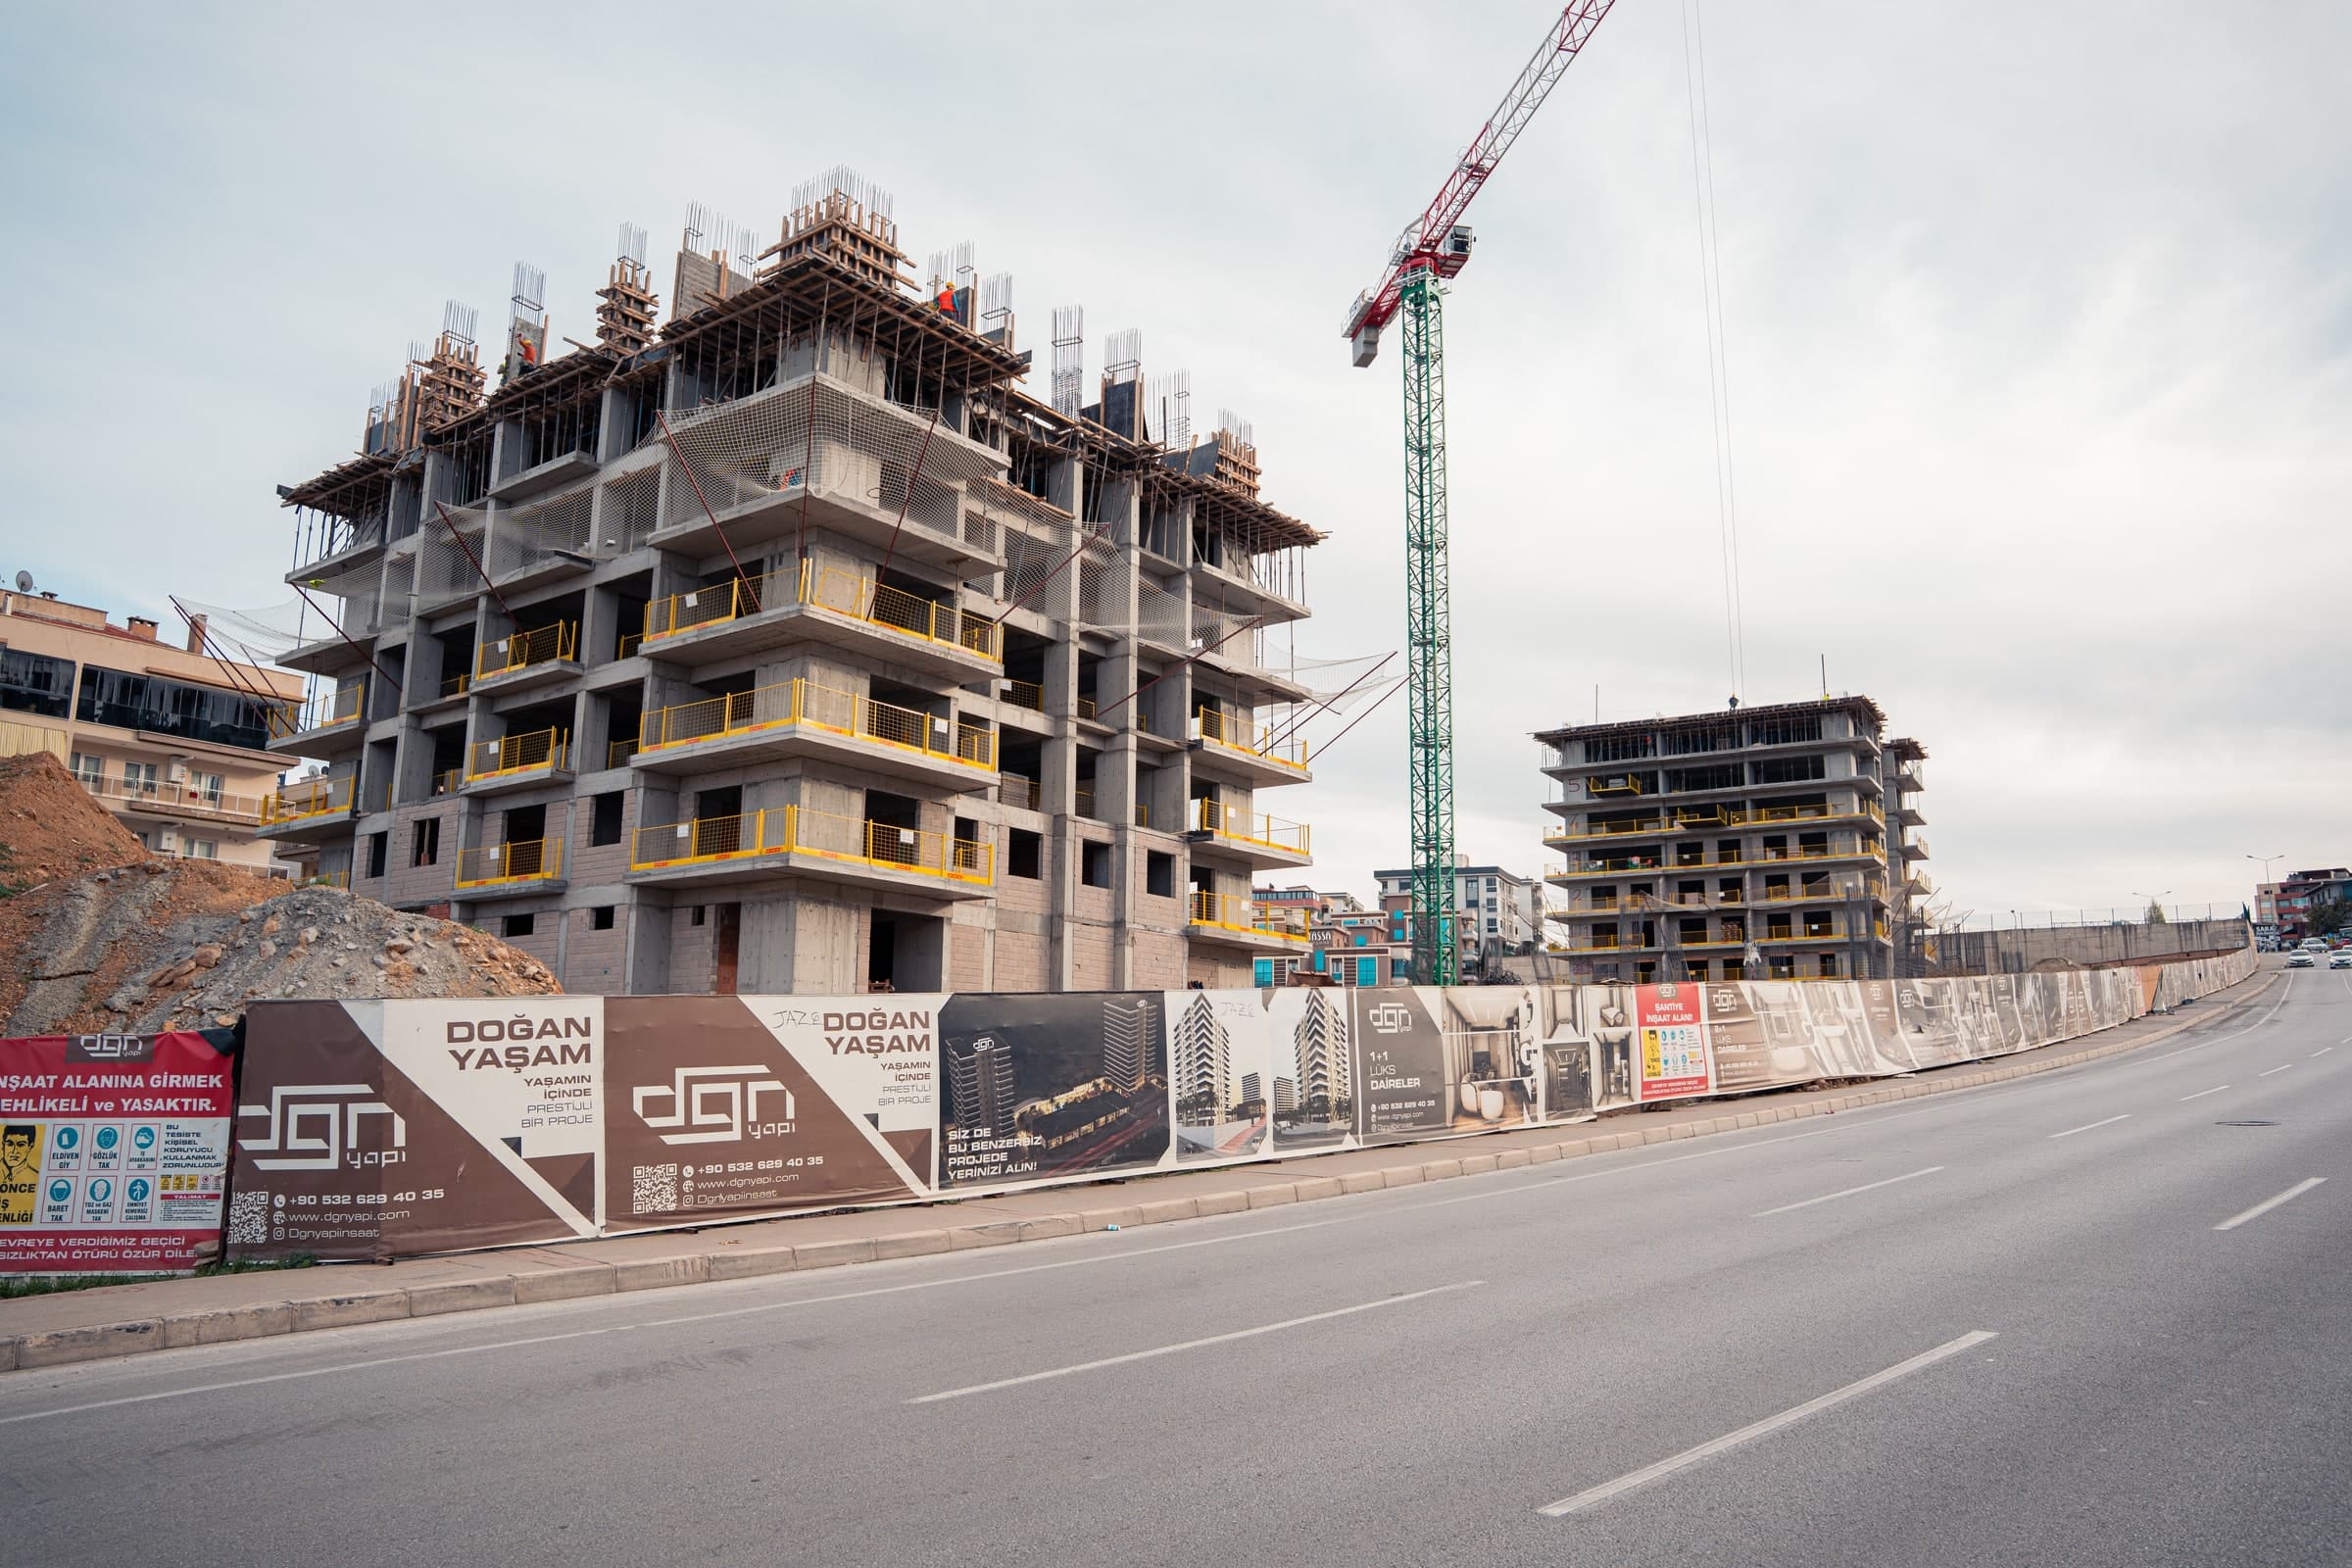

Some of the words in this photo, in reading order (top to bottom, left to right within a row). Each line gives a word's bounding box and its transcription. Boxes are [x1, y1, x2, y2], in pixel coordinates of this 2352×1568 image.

[823, 1007, 930, 1032] DOĞAN
[1369, 1003, 1412, 1034] dgn
[447, 1013, 591, 1044] DOĞAN
[80, 1035, 143, 1057] dgn
[824, 1034, 930, 1058] YAŞAM
[973, 1037, 995, 1052] dgn
[448, 1043, 592, 1074] YAŞAM
[1370, 1051, 1389, 1061] 1+1
[880, 1061, 931, 1071] YAŞAMIN
[1370, 1063, 1396, 1076] LÜKS
[63, 1075, 144, 1089] ALANINA
[149, 1072, 223, 1088] GİRMEK
[524, 1074, 592, 1088] YAŞAMIN
[895, 1072, 931, 1083] İÇİNDE
[1370, 1077, 1421, 1090] DAİRELER
[544, 1088, 593, 1102] İÇİNDE
[878, 1097, 895, 1106] BİR
[898, 1095, 931, 1104] PROJE
[0, 1096, 88, 1112] EHLİKELİ
[93, 1101, 115, 1112] ve
[121, 1098, 217, 1112] YASAKTIR.
[527, 1101, 593, 1114] PRESTİJLİ
[633, 1064, 795, 1146] dgn
[237, 1084, 406, 1171] dgn
[521, 1116, 544, 1129] BİR
[548, 1114, 593, 1127] PROJE
[949, 1127, 970, 1140] SİZ
[974, 1127, 992, 1137] DE
[949, 1142, 967, 1153] BU
[52, 1151, 79, 1159] ELDİVEN
[948, 1152, 1008, 1167] PROJEDE
[59, 1160, 71, 1169] GİY
[698, 1164, 723, 1174] +90
[727, 1162, 754, 1172] 532
[758, 1159, 783, 1169] 629
[786, 1157, 804, 1167] 40
[807, 1155, 824, 1165] 35
[948, 1164, 1002, 1180] YERİNİZİ
[1005, 1161, 1038, 1174] ALIN!
[0, 1181, 36, 1193] ÖNCE
[697, 1173, 800, 1190] www.dgnyapi.com
[289, 1195, 317, 1205] +90
[321, 1195, 352, 1205] 532
[356, 1194, 387, 1204] 629
[393, 1191, 416, 1201] 40
[422, 1189, 445, 1200] 35
[0, 1210, 33, 1223] NLİĞİ
[289, 1210, 411, 1223] www.dgnyapi.com
[289, 1228, 380, 1239] Dgnyapiinsaat
[0, 1238, 55, 1248] EVREYE
[60, 1236, 136, 1248] VERDİĞİMİZ
[140, 1235, 185, 1249] GEÇİCİ
[72, 1249, 119, 1259] ÖTÜRÜ
[122, 1249, 161, 1259] ÖZÜR
